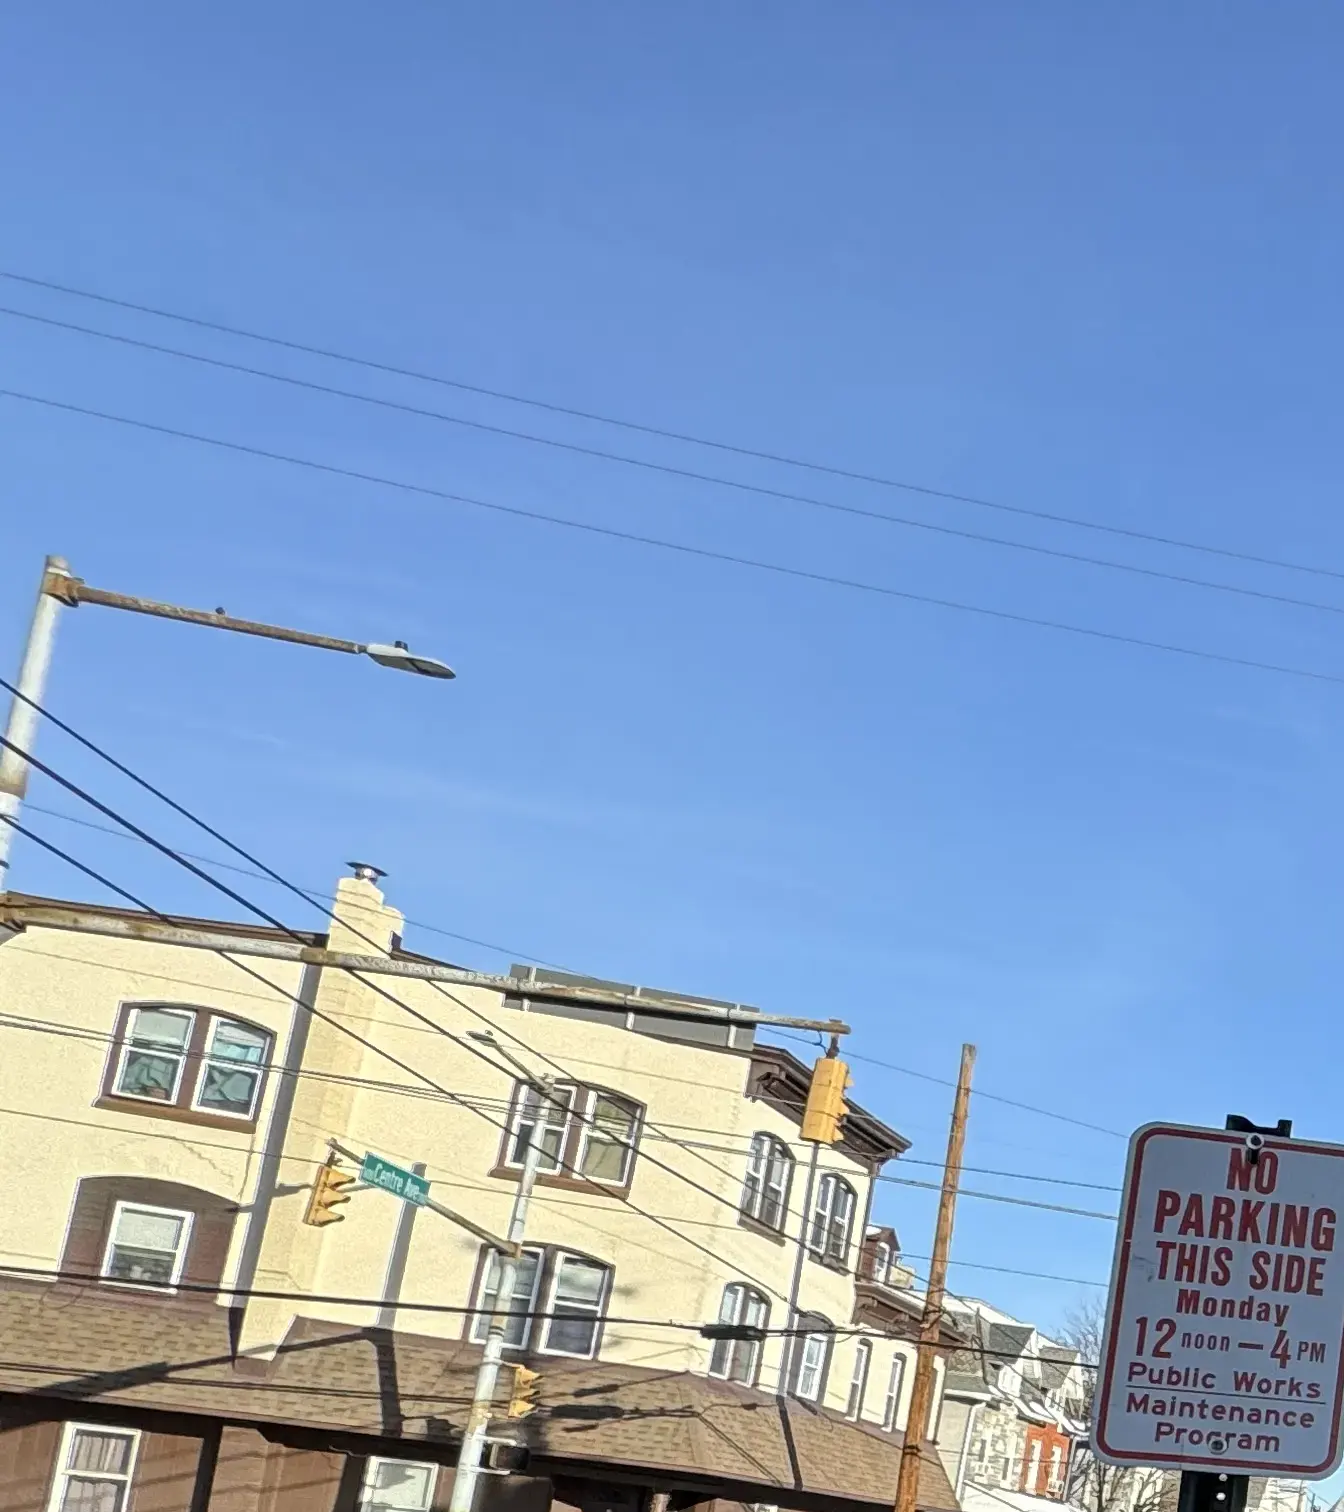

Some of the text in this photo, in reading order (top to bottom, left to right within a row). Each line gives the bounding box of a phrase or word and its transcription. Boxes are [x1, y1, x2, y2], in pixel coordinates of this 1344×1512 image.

[1226, 1147, 1279, 1195] NO
[1153, 1189, 1337, 1252] PARKING
[1155, 1240, 1328, 1297] THIS SIDE
[1176, 1288, 1291, 1327] Monday
[1134, 1316, 1178, 1359] 12
[1180, 1330, 1231, 1352] noon
[1270, 1329, 1292, 1369] 4
[1297, 1340, 1326, 1363] PM
[1127, 1362, 1322, 1399] Public Works
[1126, 1392, 1315, 1429] Maintenance
